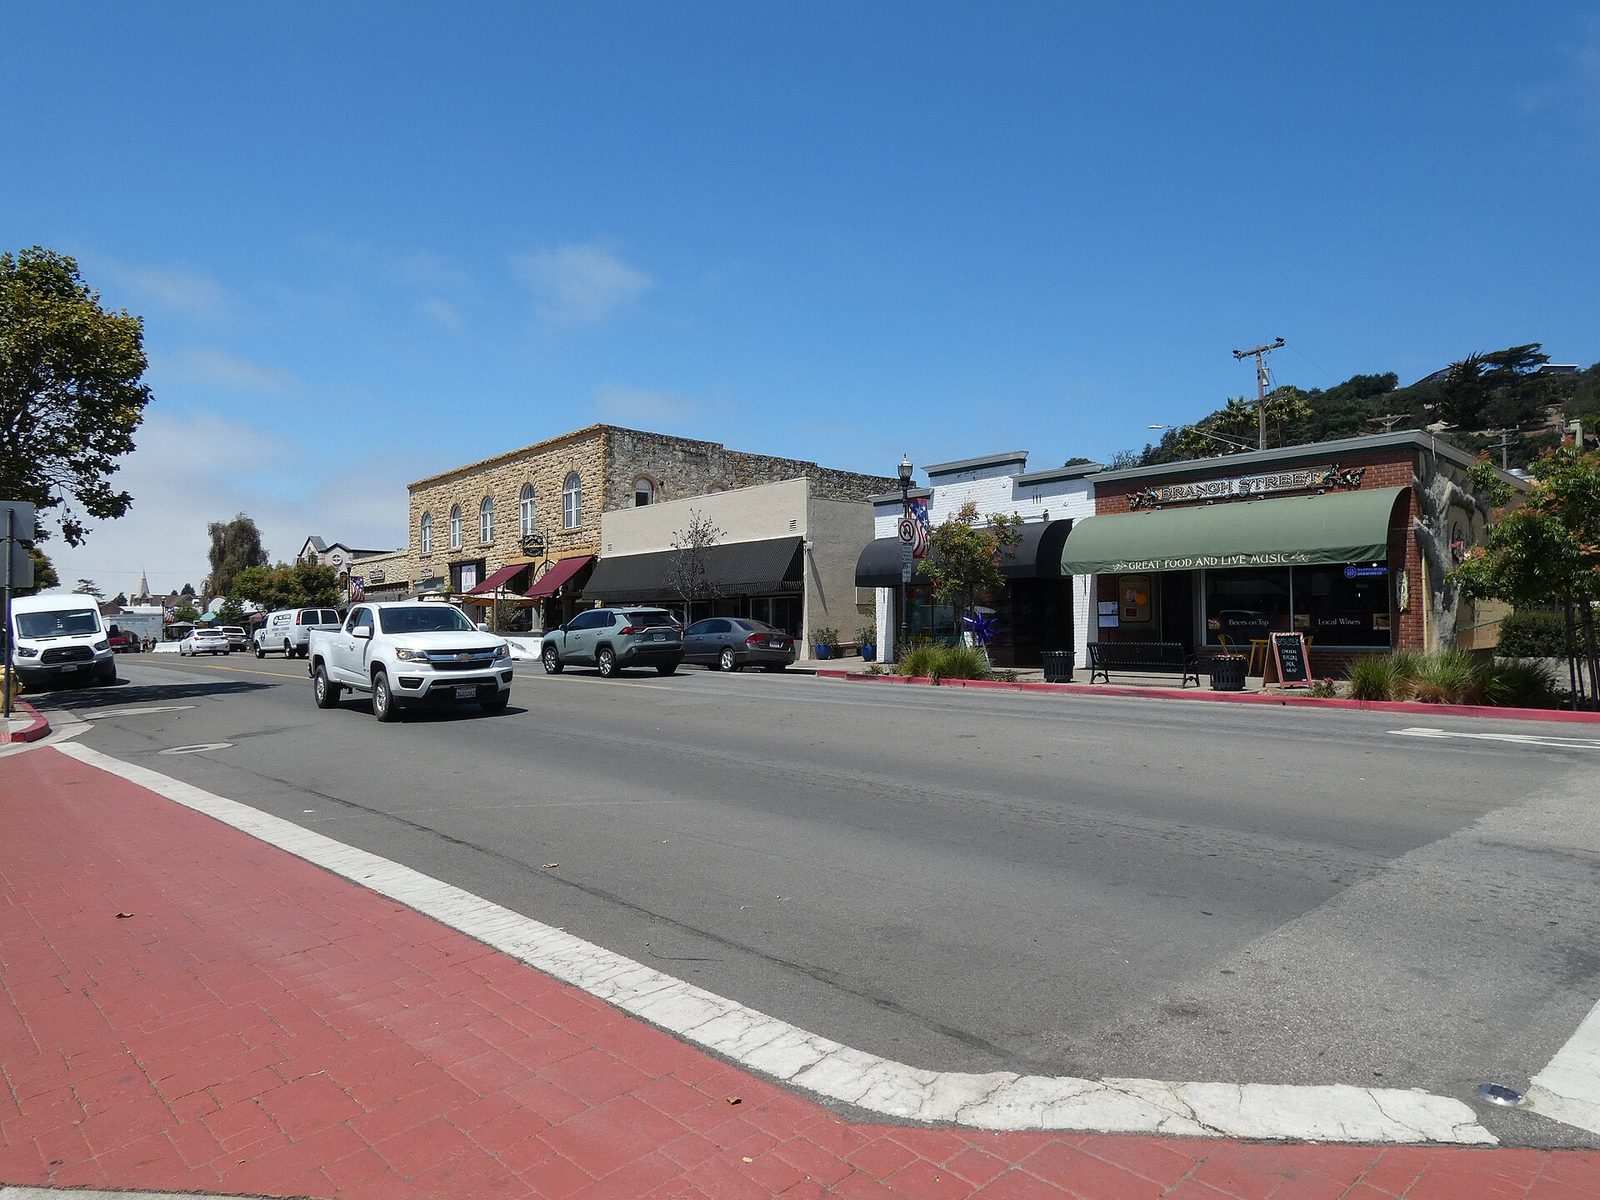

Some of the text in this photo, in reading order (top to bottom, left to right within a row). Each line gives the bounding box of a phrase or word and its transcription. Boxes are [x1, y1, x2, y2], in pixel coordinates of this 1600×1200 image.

[1160, 471, 1321, 502] BRANCH STREET
[1128, 553, 1290, 570] GREAT FOOD AND LIVE MUSIC
[1228, 618, 1248, 626] Beers
[1318, 617, 1361, 626] Local Wines
